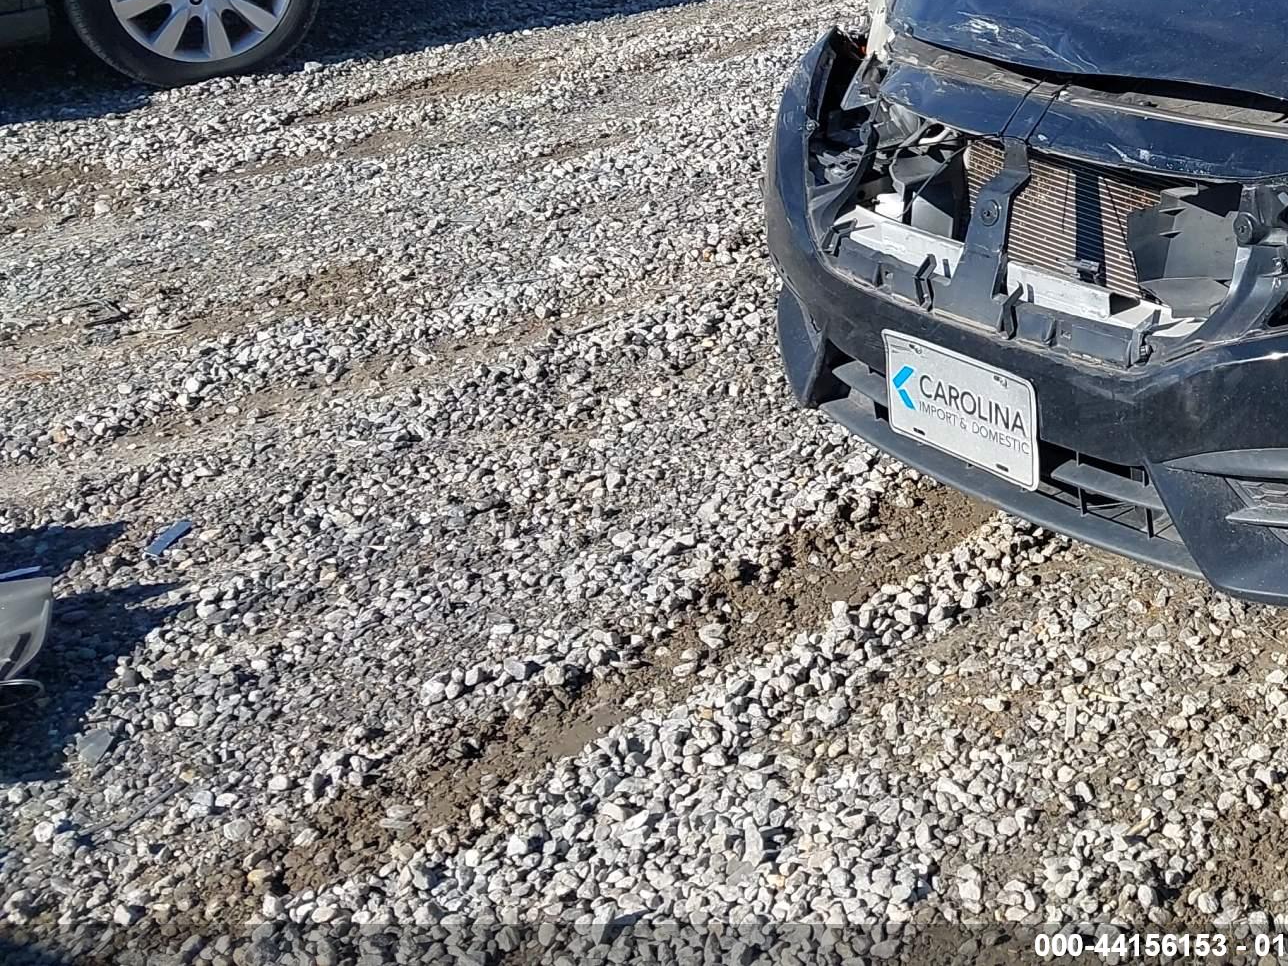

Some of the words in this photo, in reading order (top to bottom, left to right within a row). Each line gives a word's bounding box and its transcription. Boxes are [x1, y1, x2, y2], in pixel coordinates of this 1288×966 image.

[919, 374, 1027, 438] CAROLINA
[919, 401, 957, 427] IMPORT
[959, 417, 967, 430] &
[971, 421, 1030, 455] DOMESTIC
